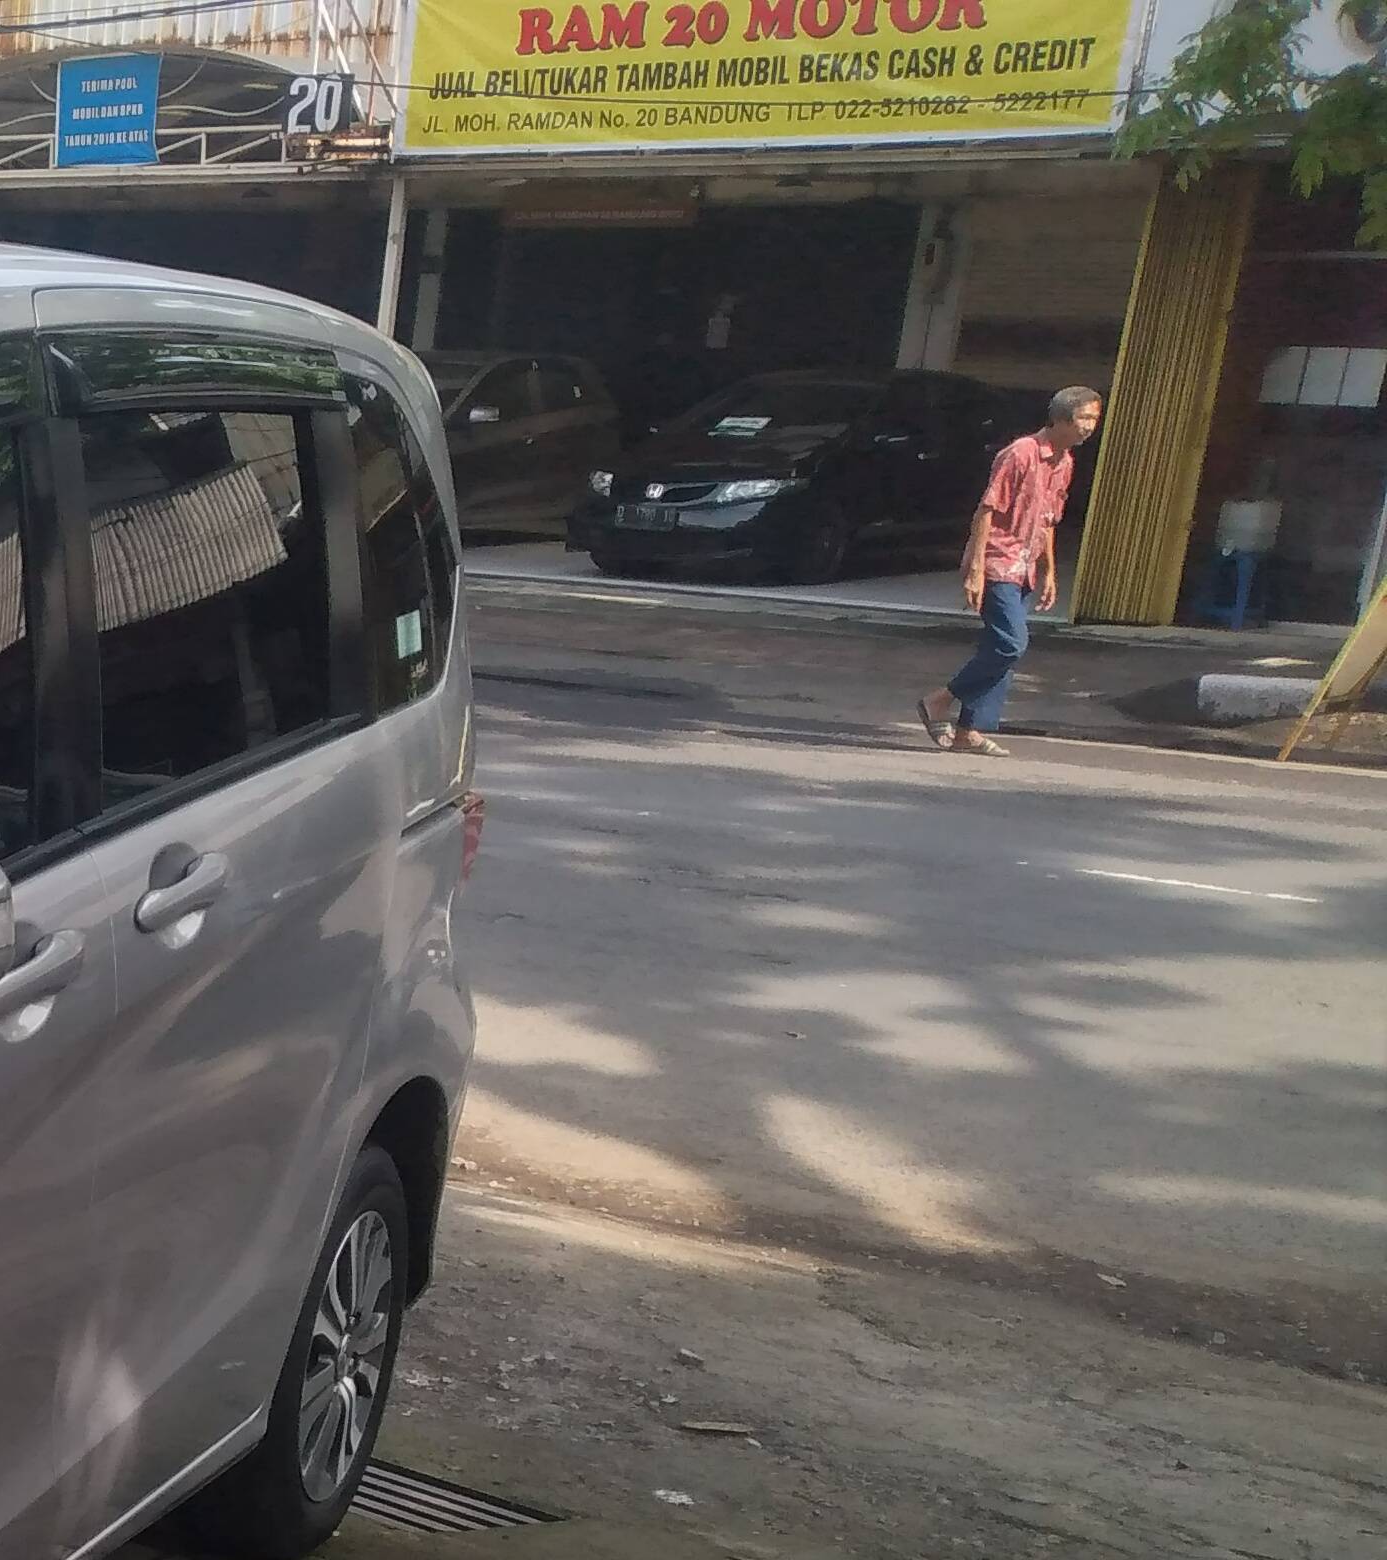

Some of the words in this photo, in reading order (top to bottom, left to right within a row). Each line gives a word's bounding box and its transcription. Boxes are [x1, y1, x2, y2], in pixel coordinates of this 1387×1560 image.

[516, 2, 648, 55] RAM
[661, 3, 730, 48] 20
[743, 0, 987, 41] MOTOR
[429, 71, 476, 100] JUAL
[616, 59, 710, 92] TAMBAH
[716, 52, 790, 88] MOBIL
[798, 49, 880, 83] BEKAS
[888, 45, 956, 79] CASH
[964, 43, 984, 76] &
[993, 37, 1096, 75] CREDIT
[81, 78, 114, 93] TERIMA
[72, 106, 100, 120] MOBIL
[287, 76, 343, 134] 20
[507, 110, 592, 131] RAMDAN
[636, 108, 658, 127] 20
[664, 102, 771, 126] BANDUNG
[65, 133, 92, 147] TAHUN
[129, 129, 149, 143] ATAS
